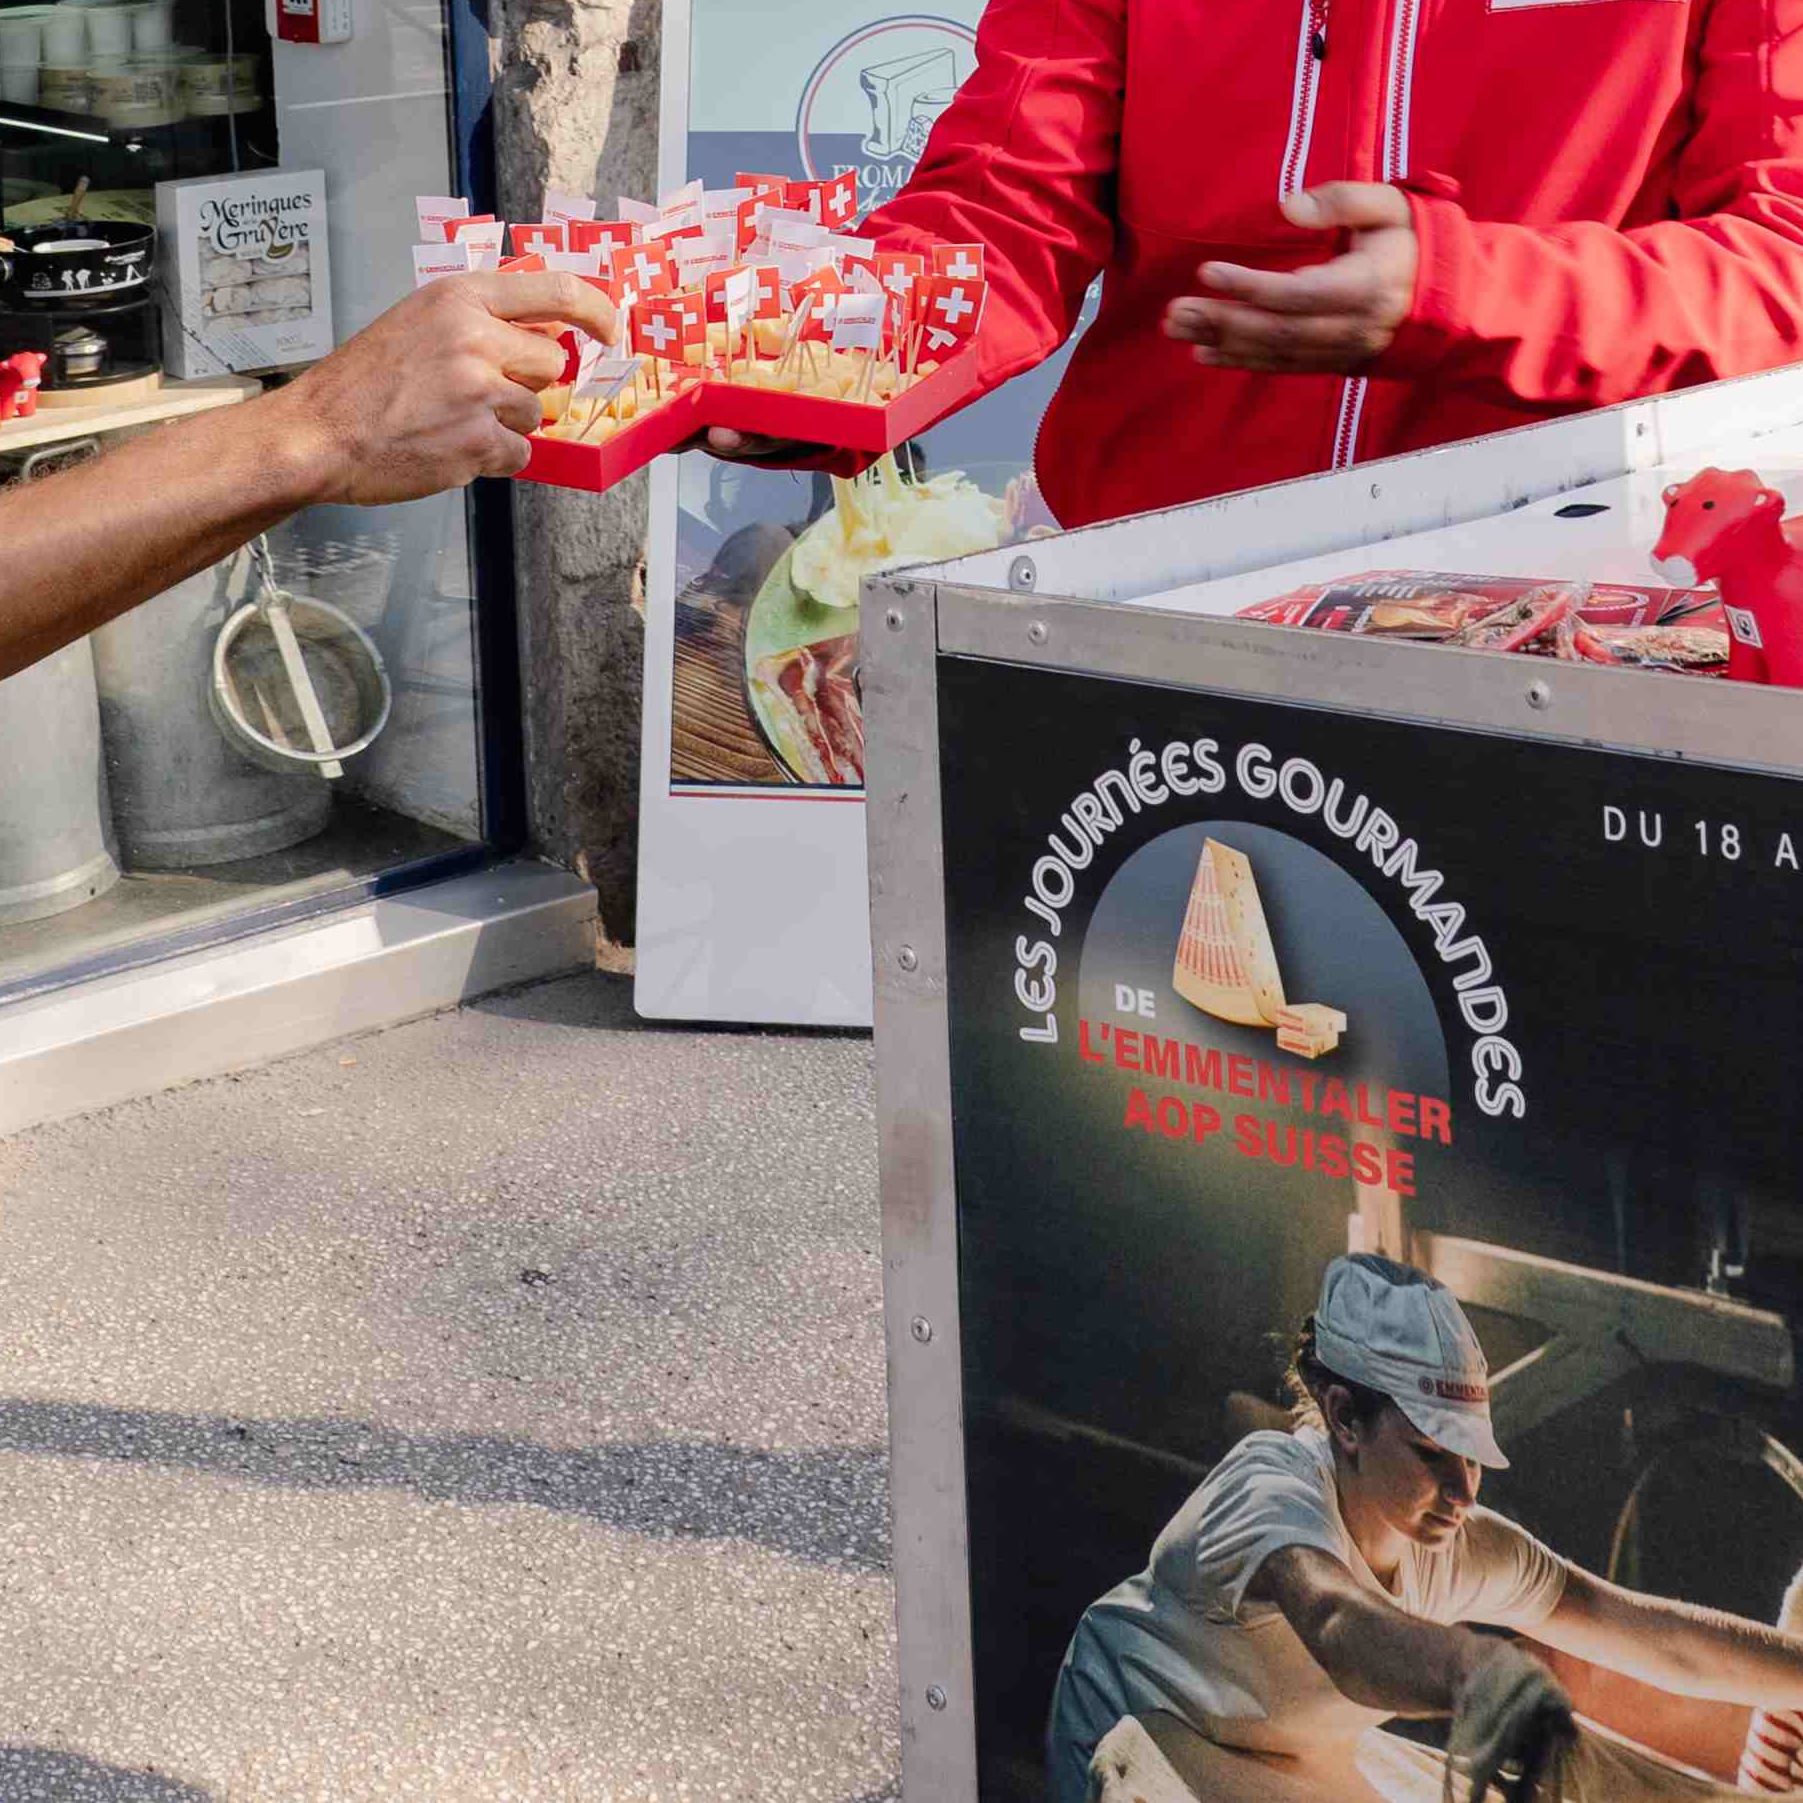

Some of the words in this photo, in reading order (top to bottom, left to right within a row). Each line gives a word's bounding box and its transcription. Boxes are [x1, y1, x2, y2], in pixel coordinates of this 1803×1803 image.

[199, 192, 314, 228] Meringues
[832, 164, 913, 189] FROM
[1023, 737, 1227, 937] JOURNÉES
[1602, 804, 1664, 848] DU
[1694, 818, 1742, 861] 18
[1235, 742, 1526, 1119] GOURMANDES
[1014, 934, 1059, 1044] LES
[1114, 983, 1157, 1019] DE
[1077, 1019, 1454, 1146] L'EMMENTALER
[1123, 1087, 1222, 1146] AOP
[1233, 1113, 1418, 1197] SUISSE
